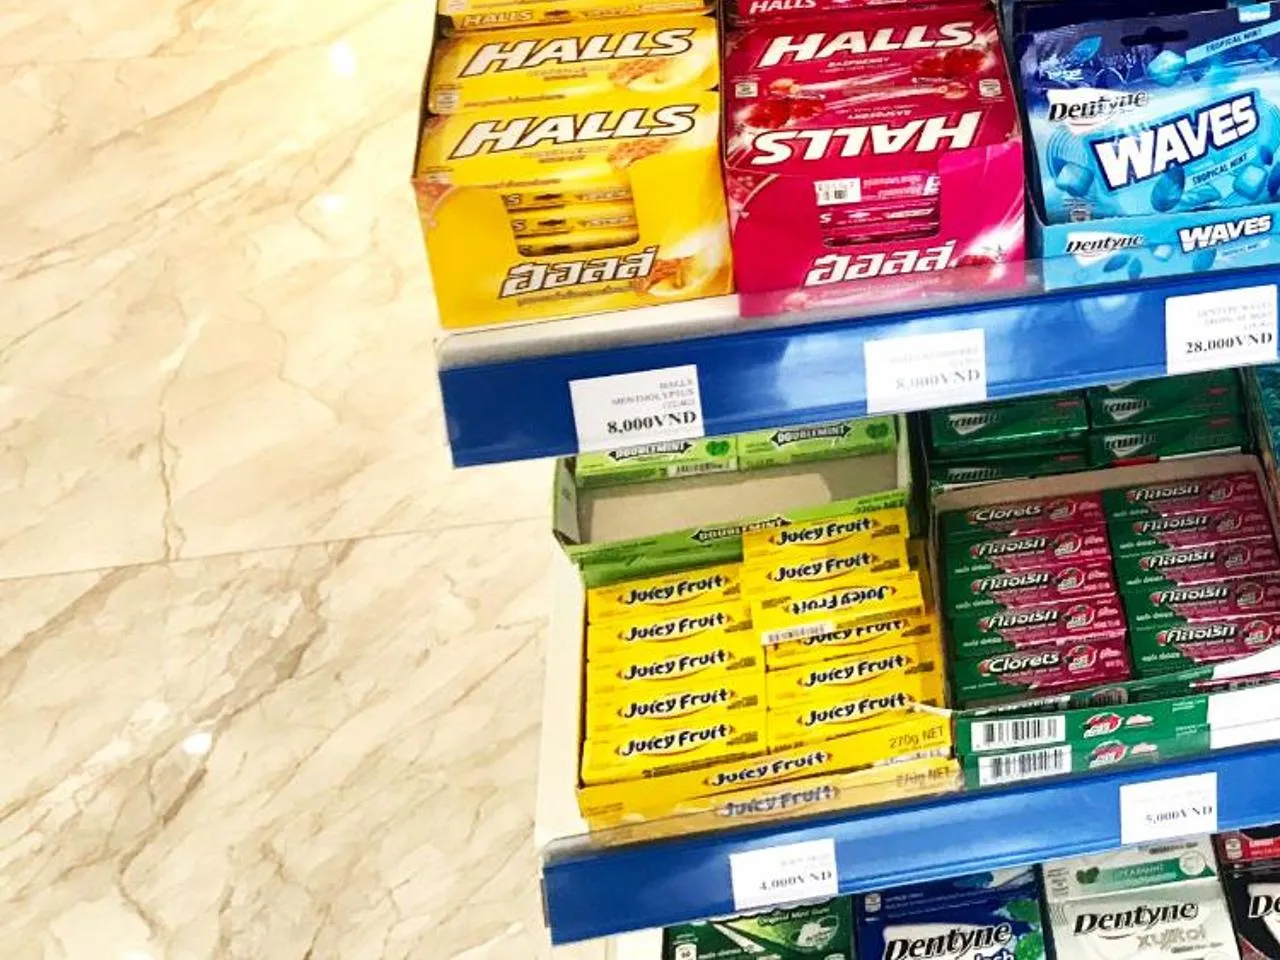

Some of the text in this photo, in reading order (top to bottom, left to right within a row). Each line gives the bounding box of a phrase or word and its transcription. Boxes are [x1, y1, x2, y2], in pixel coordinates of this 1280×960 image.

[458, 27, 697, 78] HALLS
[758, 22, 977, 68] HALLS
[448, 104, 700, 161] HALLS
[750, 110, 985, 166] HALLS
[1095, 95, 1257, 188] WAVES
[1066, 234, 1144, 257] Dentyne
[1180, 215, 1272, 251] WAVES
[1186, 332, 1273, 355] 28,000VND
[607, 410, 697, 434] 8,000VND
[975, 504, 1042, 521] Clorets
[777, 518, 872, 546] Juicy Fruit
[775, 553, 871, 582] Juicy Fruit
[624, 575, 722, 606] Juicy Fruit
[793, 586, 888, 615] Juicy Fruit
[625, 613, 725, 642] Juicy Fruit
[625, 650, 726, 680] Juicy Fruit
[806, 654, 905, 687] Juicy Fruit
[988, 652, 1060, 674] Clorets
[625, 688, 727, 719] Juicy Fruit
[807, 692, 906, 727] Juicy Fruit
[622, 724, 727, 756] Juicy Fruit
[889, 725, 945, 749] 270g NET
[712, 751, 826, 786] Juicy Fruit
[760, 870, 832, 891] 4,000VND
[1074, 900, 1199, 936] Dentyne
[886, 922, 1012, 960] Dentyne
